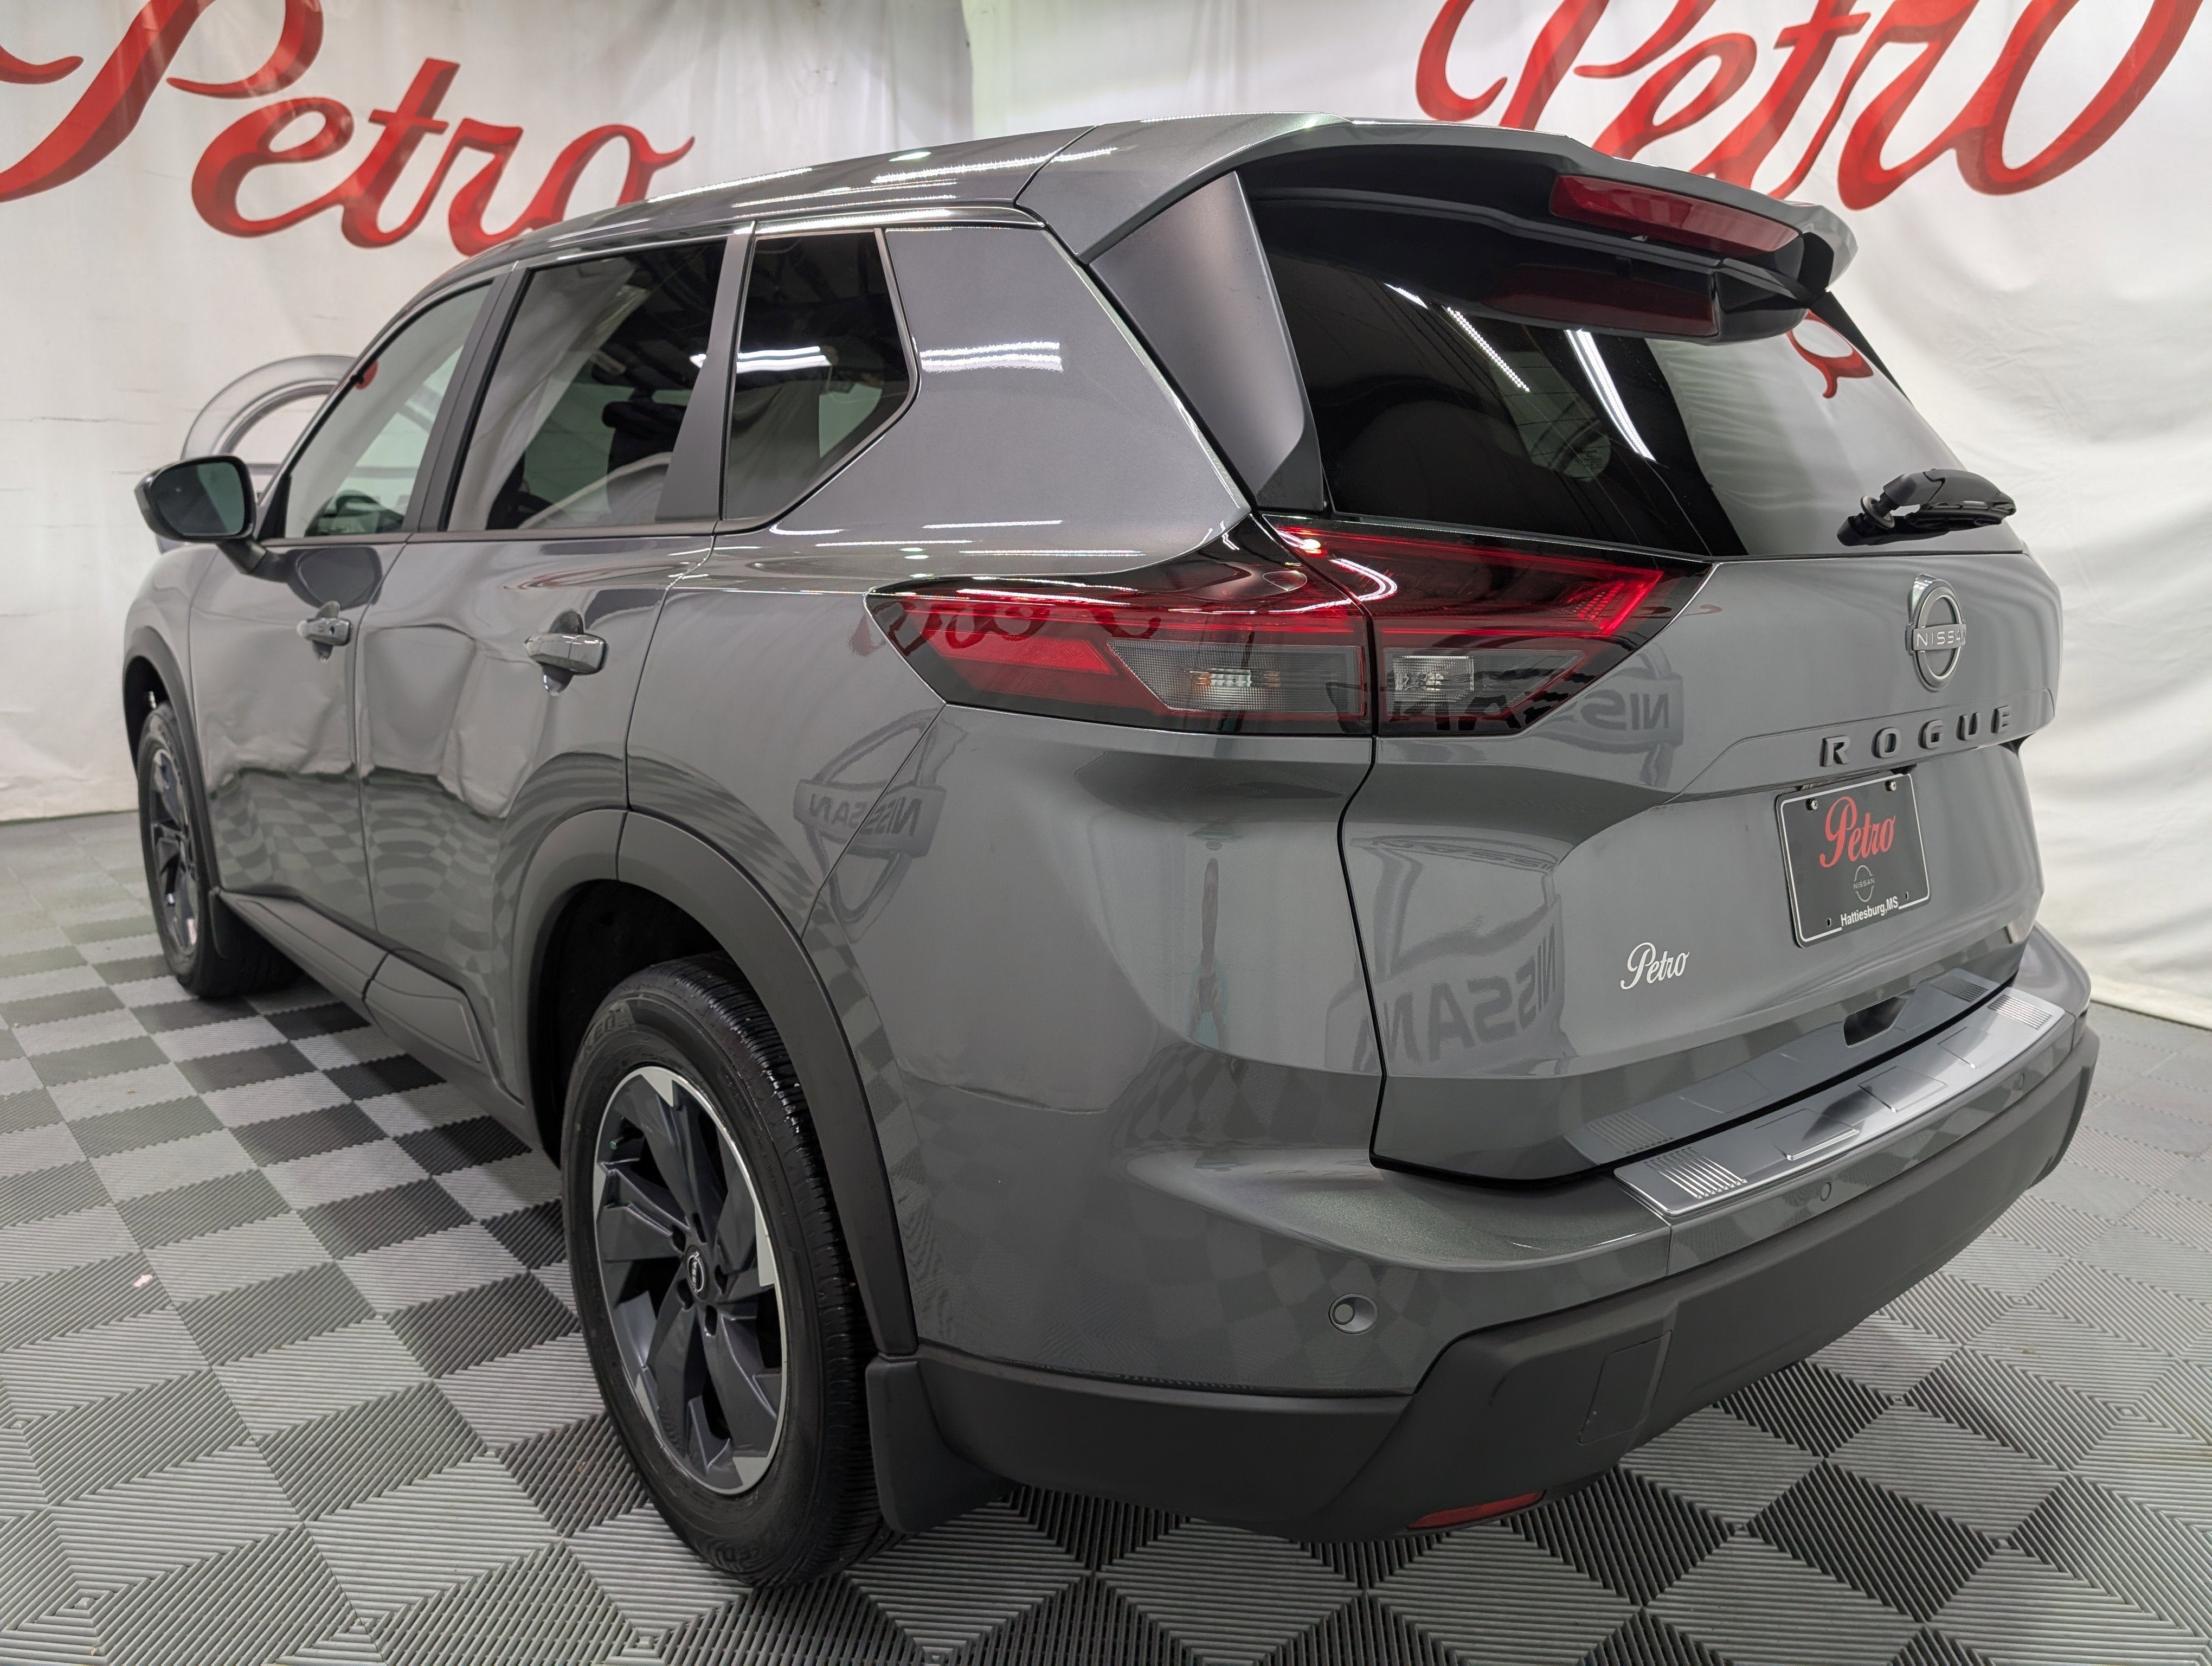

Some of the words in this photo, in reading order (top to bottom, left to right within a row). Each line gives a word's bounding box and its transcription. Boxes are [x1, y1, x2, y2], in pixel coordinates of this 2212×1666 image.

[0, 0, 695, 257] Petro
[1916, 628, 1966, 648] NISSAN
[1819, 704, 2012, 767] ROGUE
[1819, 796, 1896, 868] Petro
[1853, 877, 1875, 890] NISSAN
[1620, 942, 1690, 990] Petro
